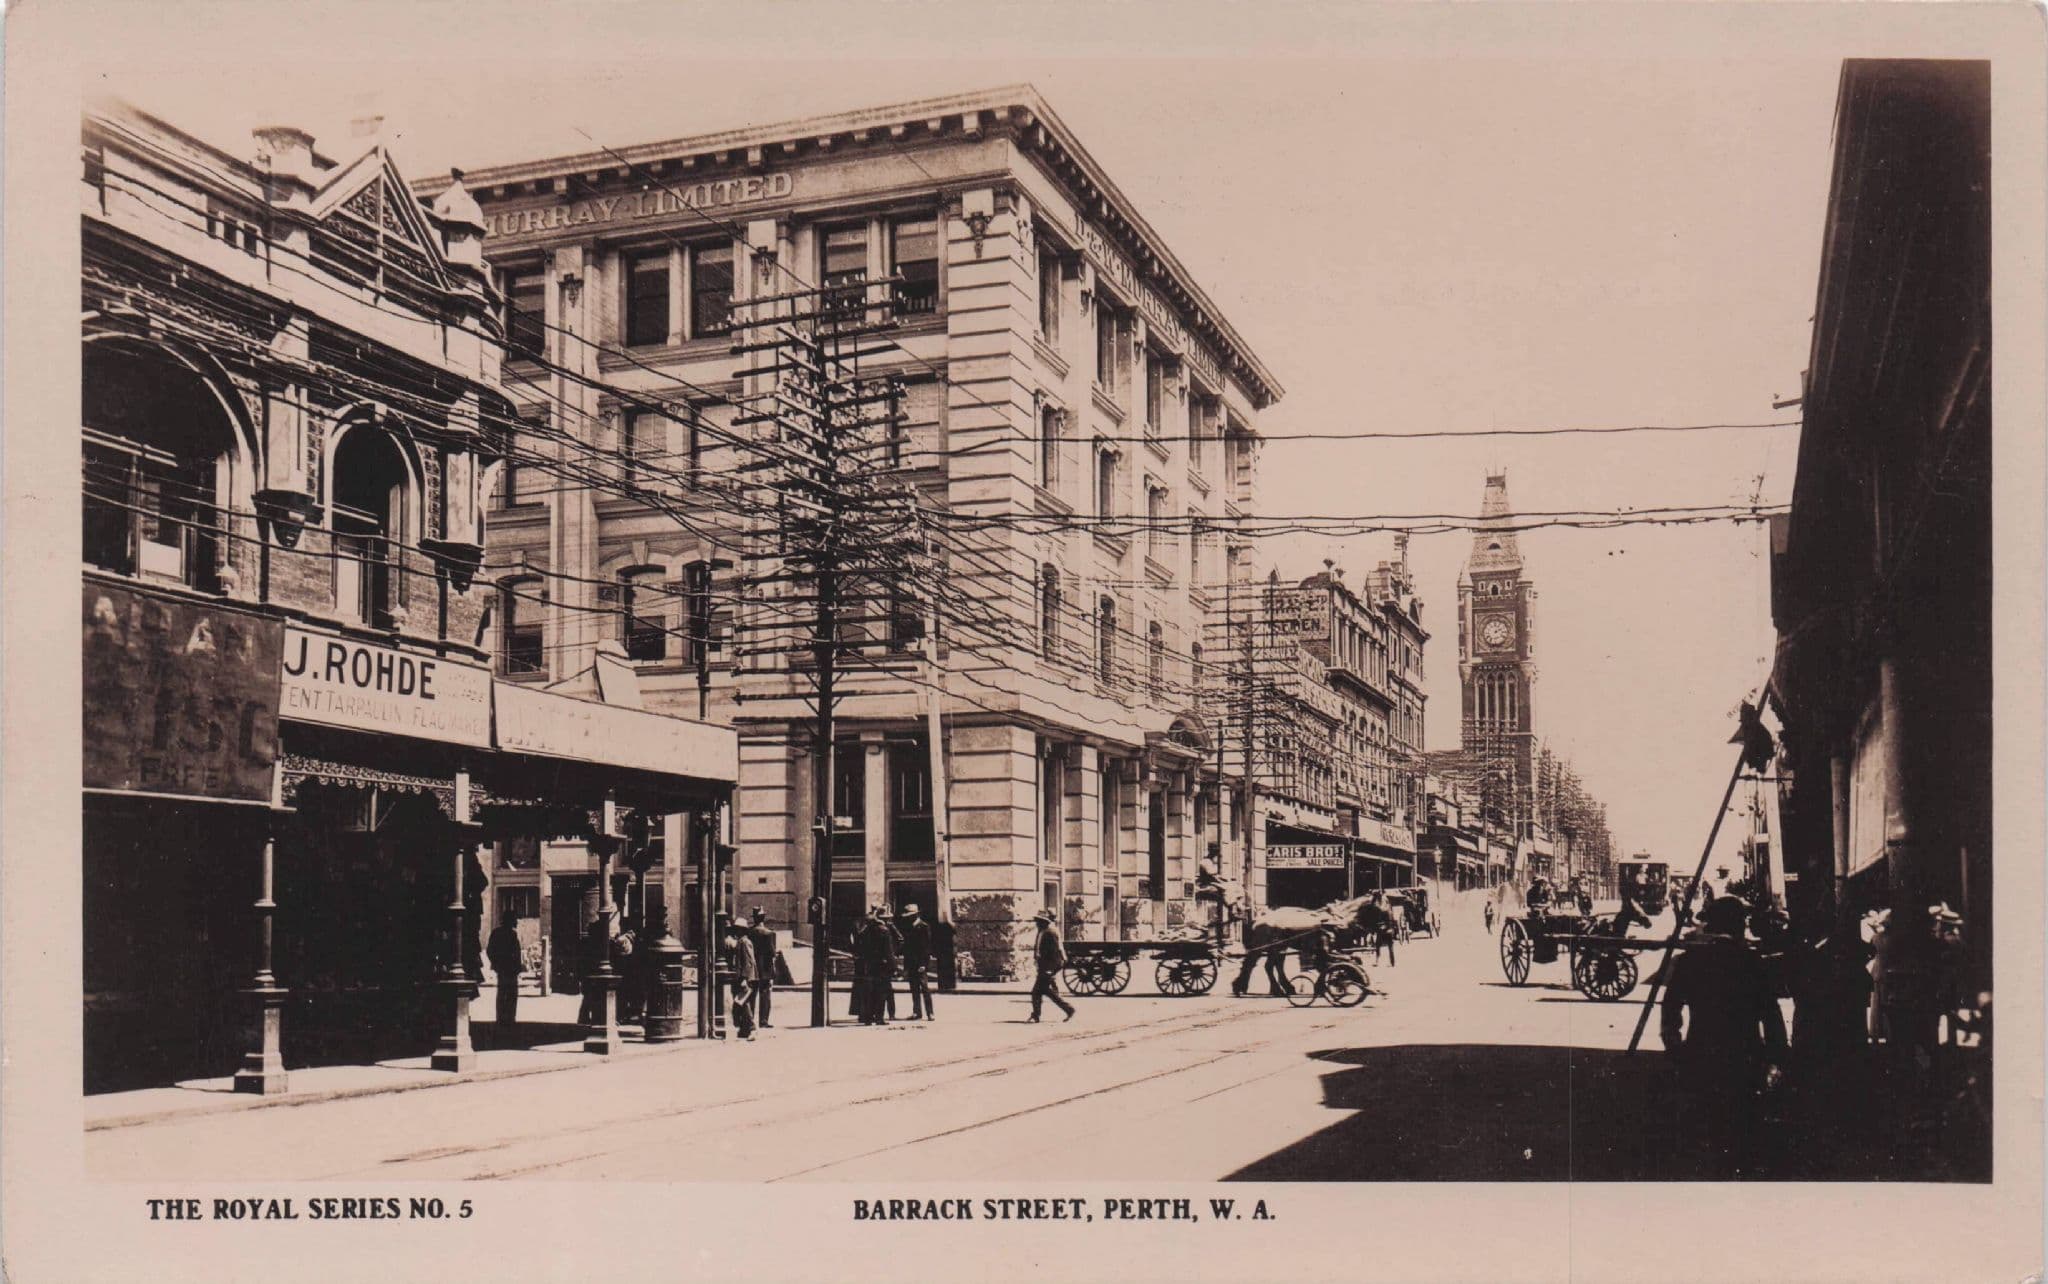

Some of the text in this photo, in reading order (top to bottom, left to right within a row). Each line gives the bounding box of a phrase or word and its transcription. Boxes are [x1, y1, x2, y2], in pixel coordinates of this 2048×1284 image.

[633, 173, 793, 220] LIMITED
[327, 689, 401, 724] TARPAULIN
[1266, 847, 1302, 858] CARIS
